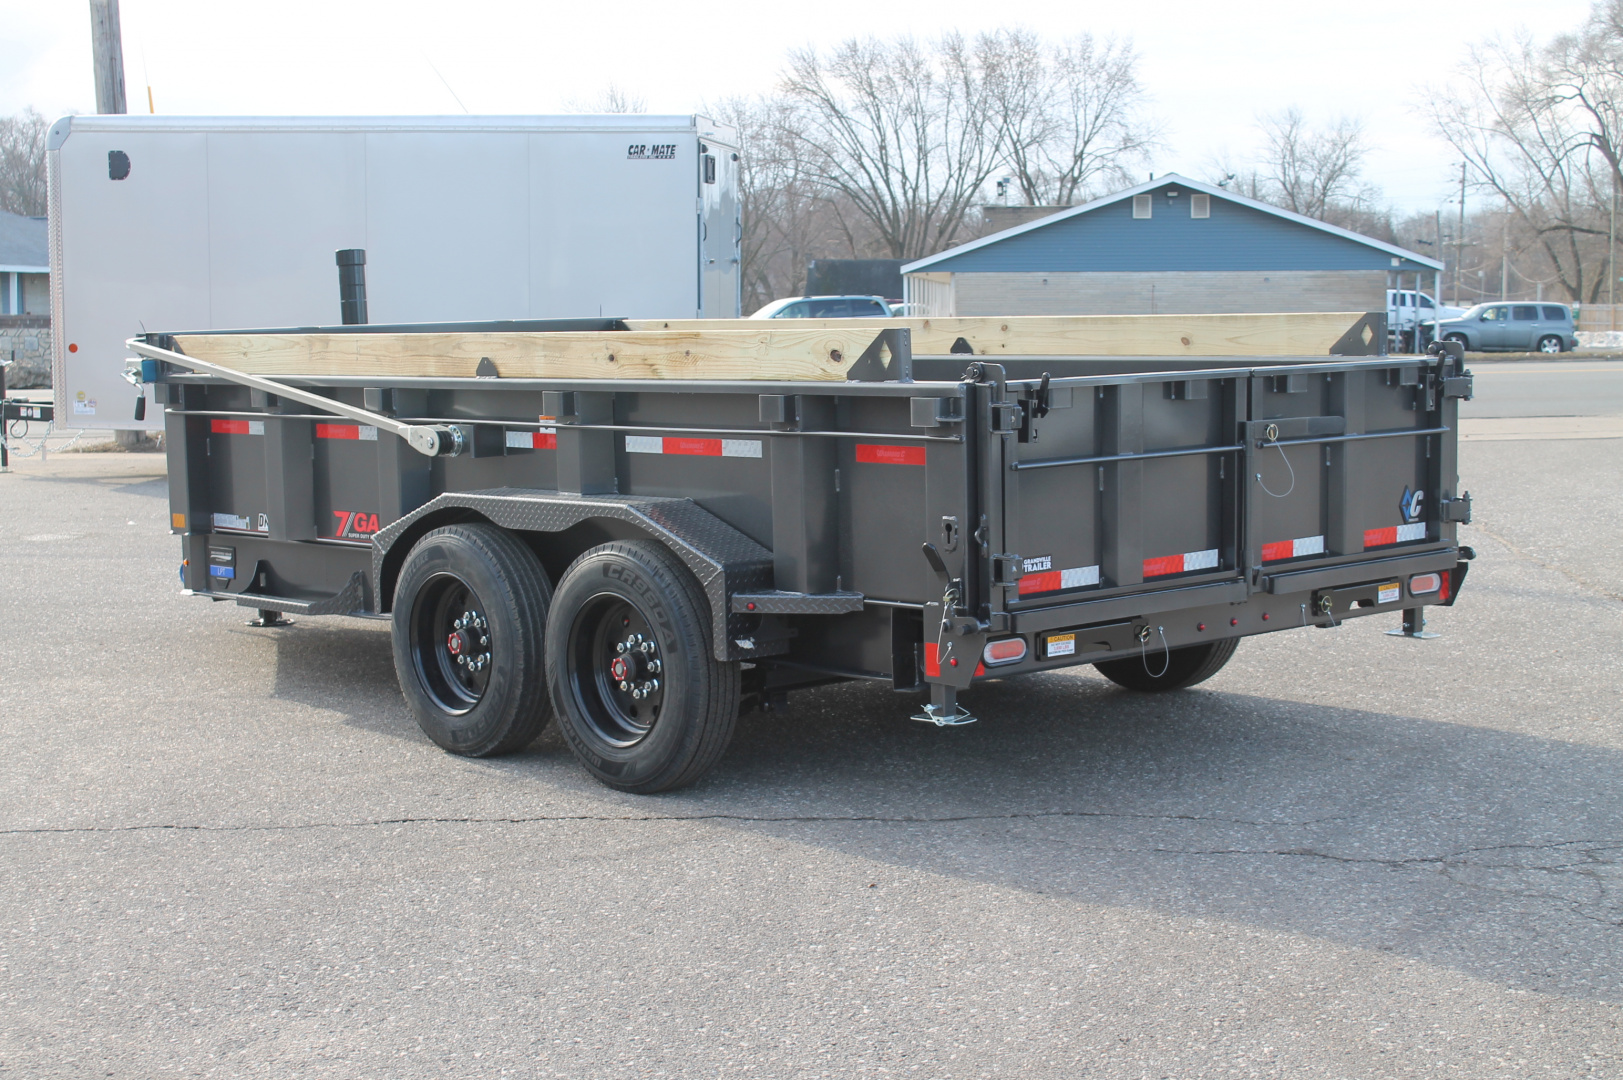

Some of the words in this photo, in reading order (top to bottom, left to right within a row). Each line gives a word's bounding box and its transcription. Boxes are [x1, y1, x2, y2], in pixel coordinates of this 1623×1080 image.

[628, 144, 646, 155] CAR
[651, 144, 676, 155] MATE
[1023, 556, 1051, 565] GRANDVILLE
[1023, 561, 1051, 572] TRAILER
[607, 563, 675, 647] CR960A
